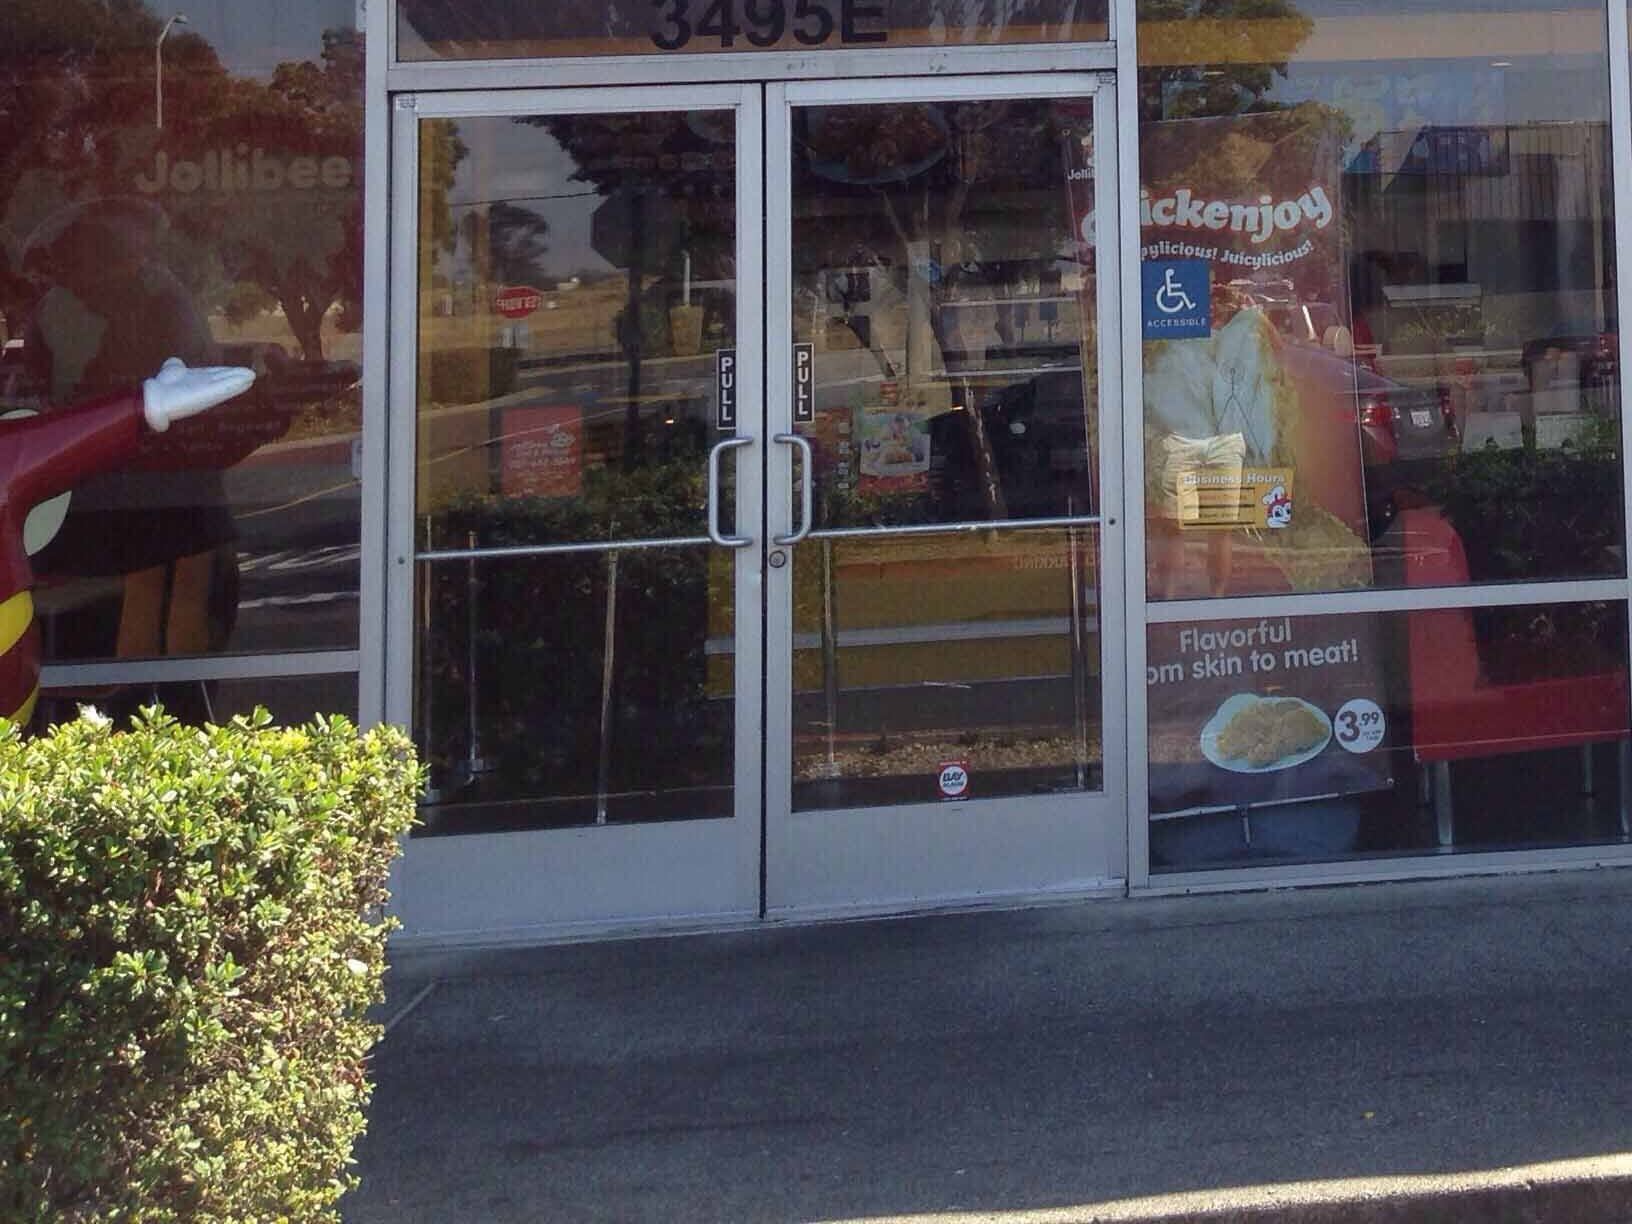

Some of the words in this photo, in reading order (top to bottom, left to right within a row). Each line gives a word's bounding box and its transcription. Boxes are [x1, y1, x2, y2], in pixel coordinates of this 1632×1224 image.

[134, 142, 353, 193] Jollibee
[1220, 239, 1315, 271] Juicylicious!
[1147, 316, 1207, 328] ACCESSIBLE
[721, 356, 734, 421] PULL
[797, 351, 809, 416] PULL
[1247, 471, 1285, 485] Hours
[1180, 617, 1291, 654] Flavorful
[1192, 652, 1242, 680] skin
[1252, 649, 1276, 672] to
[1284, 638, 1358, 669] meat!
[1339, 710, 1380, 743] 3.99
